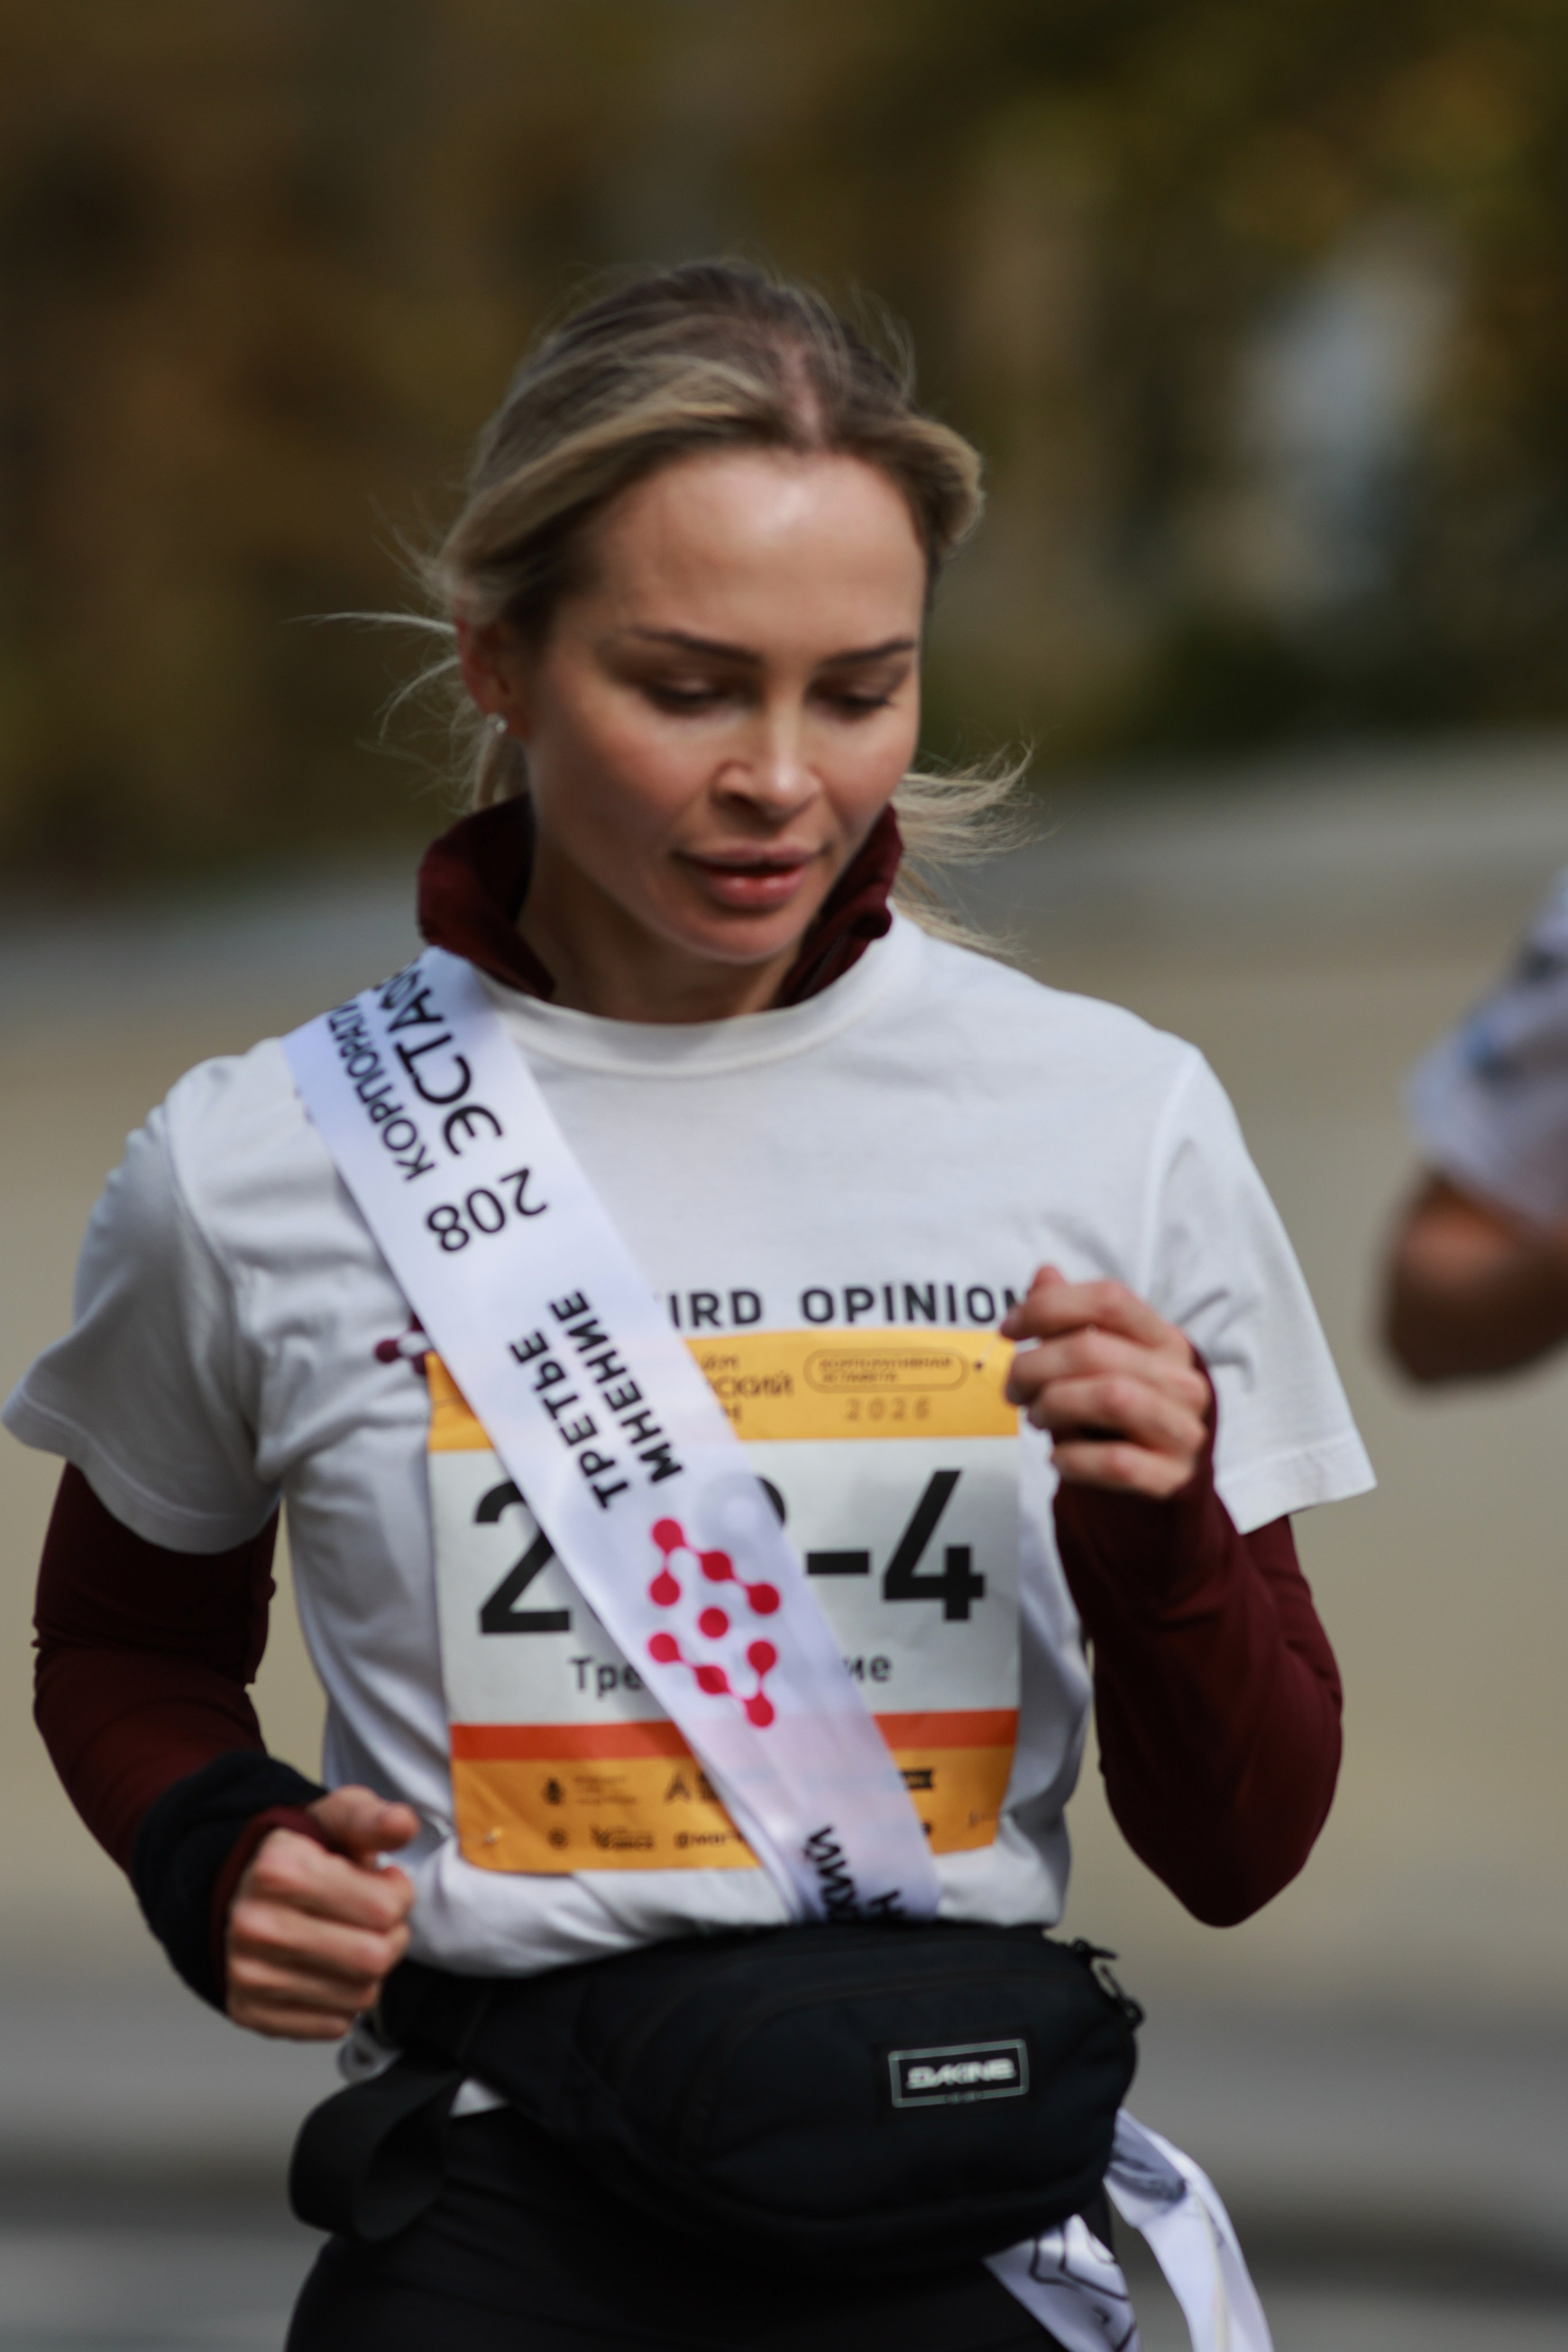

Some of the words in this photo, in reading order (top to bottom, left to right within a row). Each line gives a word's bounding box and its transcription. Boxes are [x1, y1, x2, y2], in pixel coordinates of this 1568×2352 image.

[426, 1167, 548, 1253] 208
[669, 1290, 762, 1329] IRD
[509, 1330, 629, 1510] ТРЕТЬЕ
[549, 1291, 683, 1484] МНЕНИЕ
[569, 1656, 643, 1698] Тре
